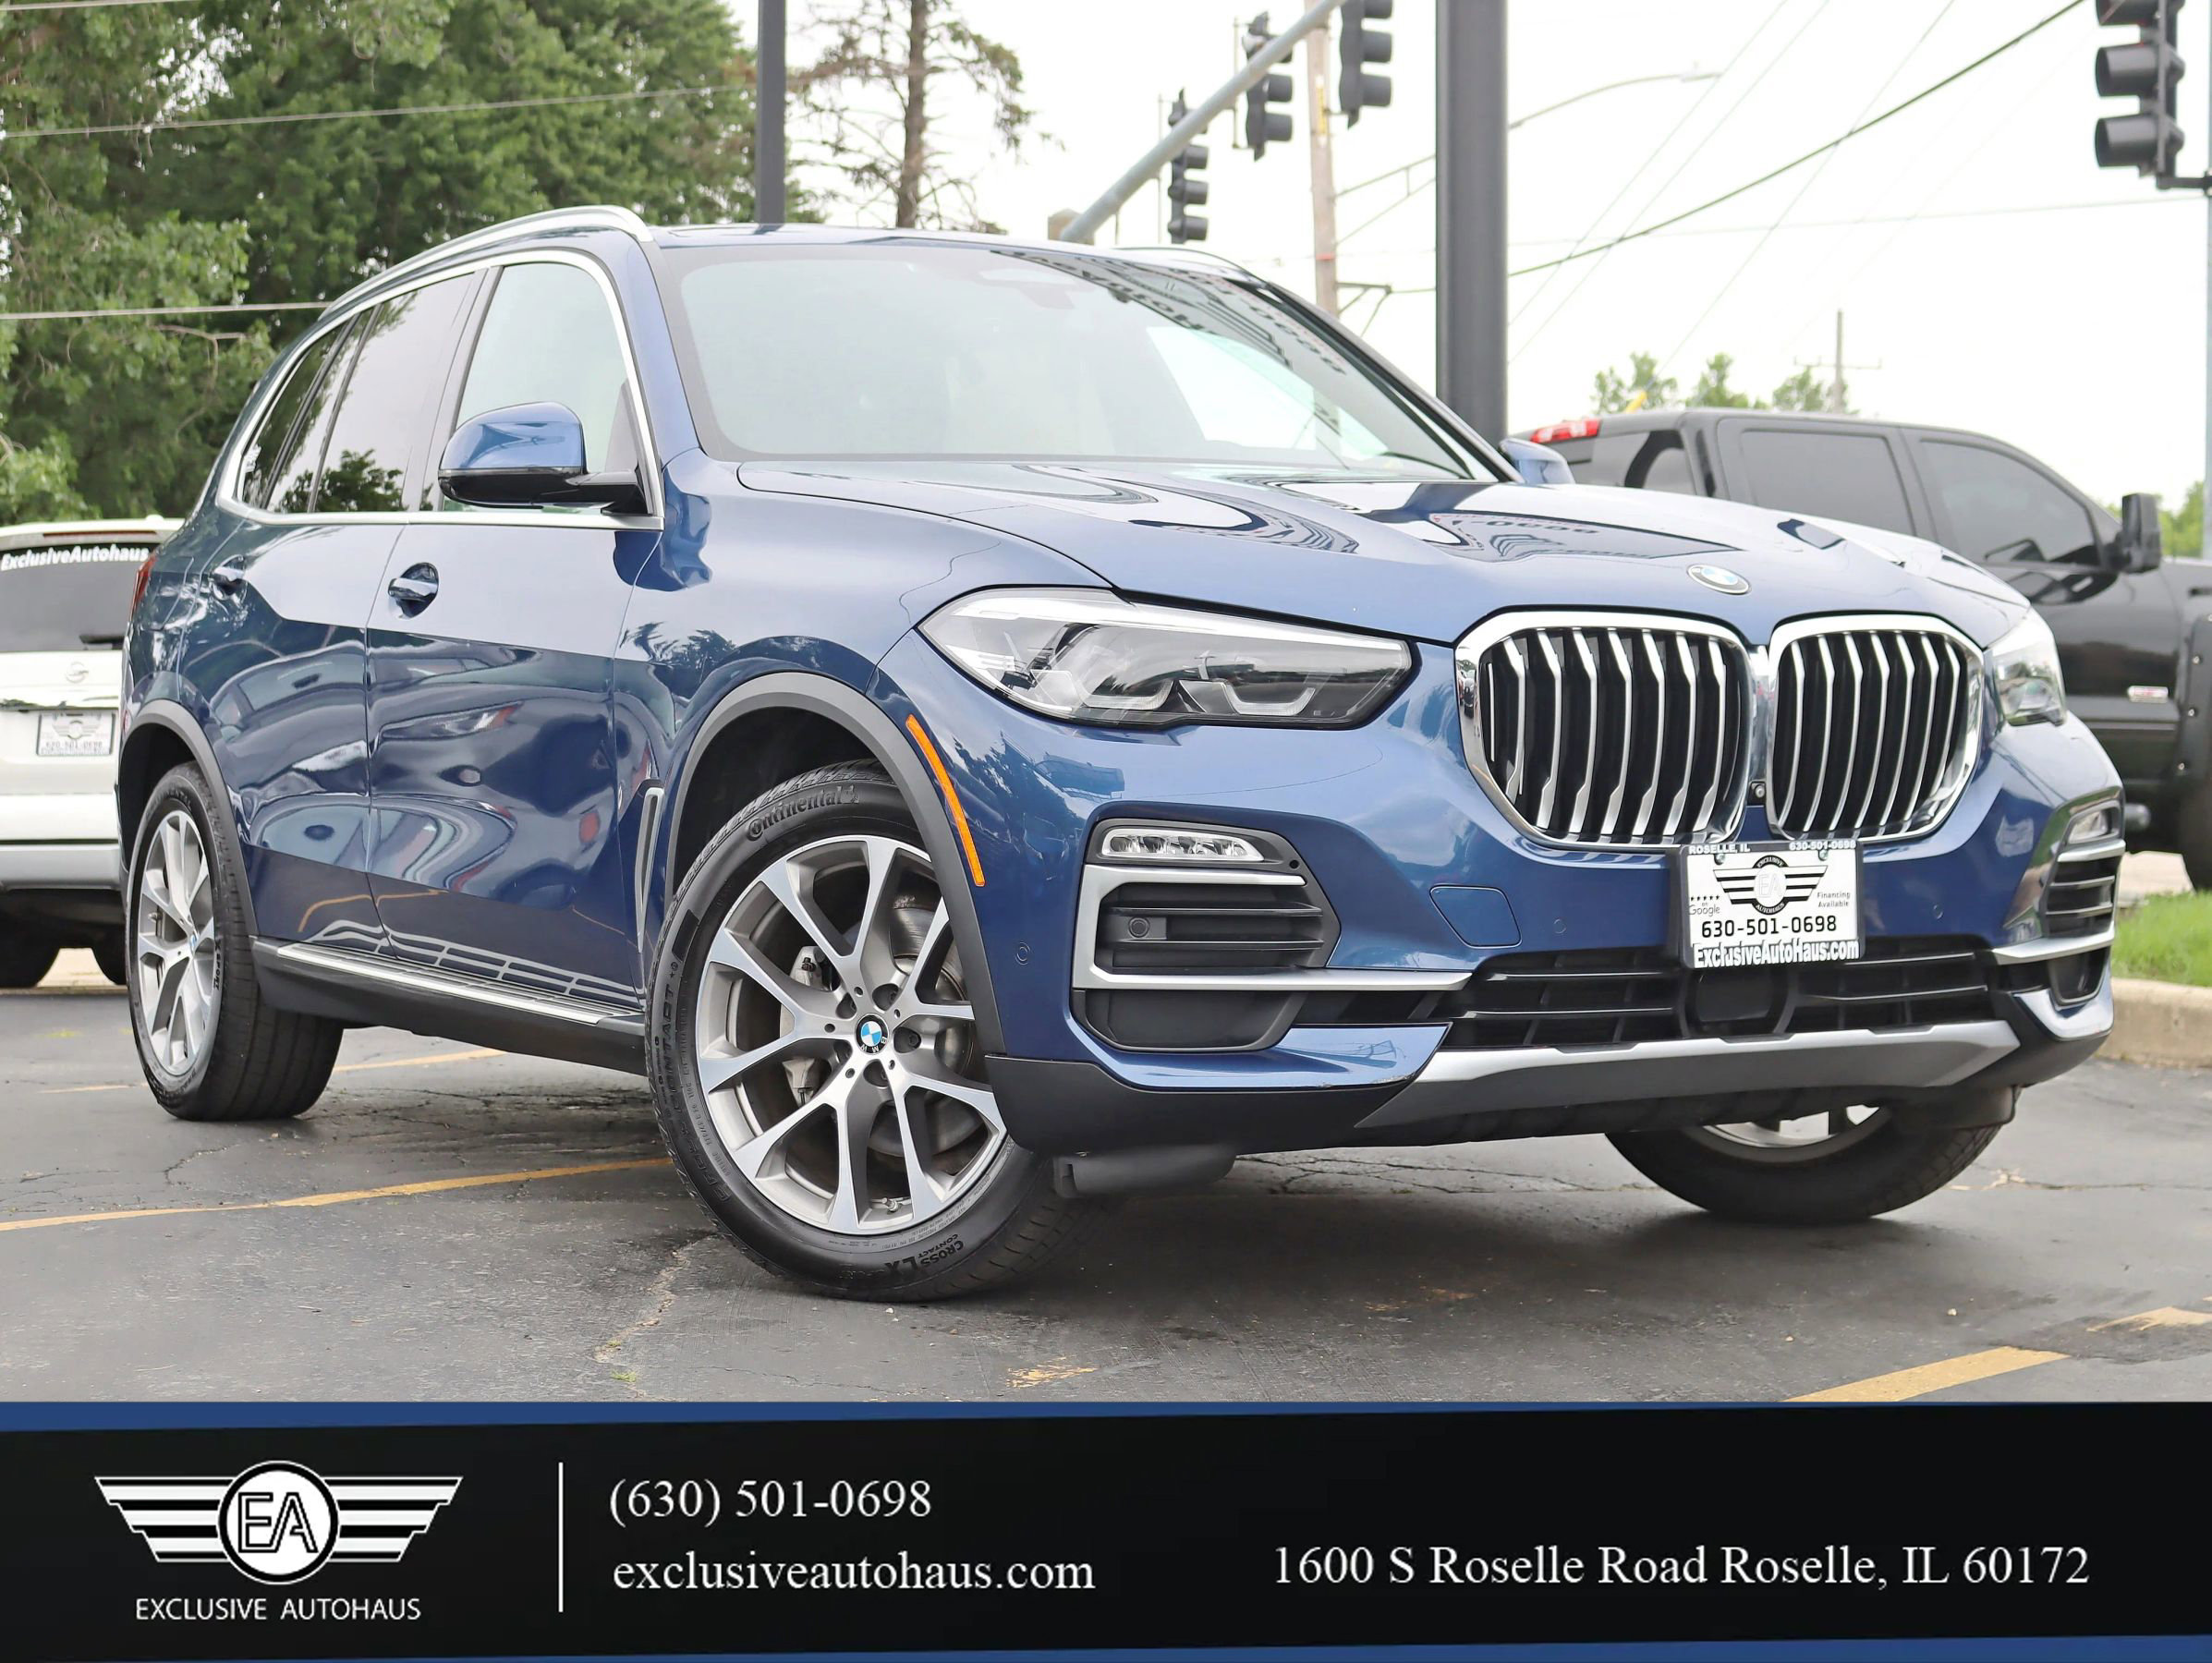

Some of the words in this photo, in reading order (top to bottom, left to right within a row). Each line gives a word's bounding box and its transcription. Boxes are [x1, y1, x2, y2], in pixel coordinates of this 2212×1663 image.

[747, 785, 842, 841] Continental
[1689, 844, 1737, 854] ROSELLE,
[1740, 843, 1750, 852] IL
[1789, 840, 1856, 851] 630-501-0698
[1817, 891, 1851, 900] Financing
[1817, 900, 1850, 908] Available
[1689, 904, 1720, 917] Google
[1702, 915, 1837, 938] 630-501-0698
[1693, 938, 1860, 969] ExclusiveAutoHaus.com
[918, 1233, 958, 1257] CONTACT
[919, 1240, 965, 1268] CROSS
[885, 1256, 918, 1273] LX
